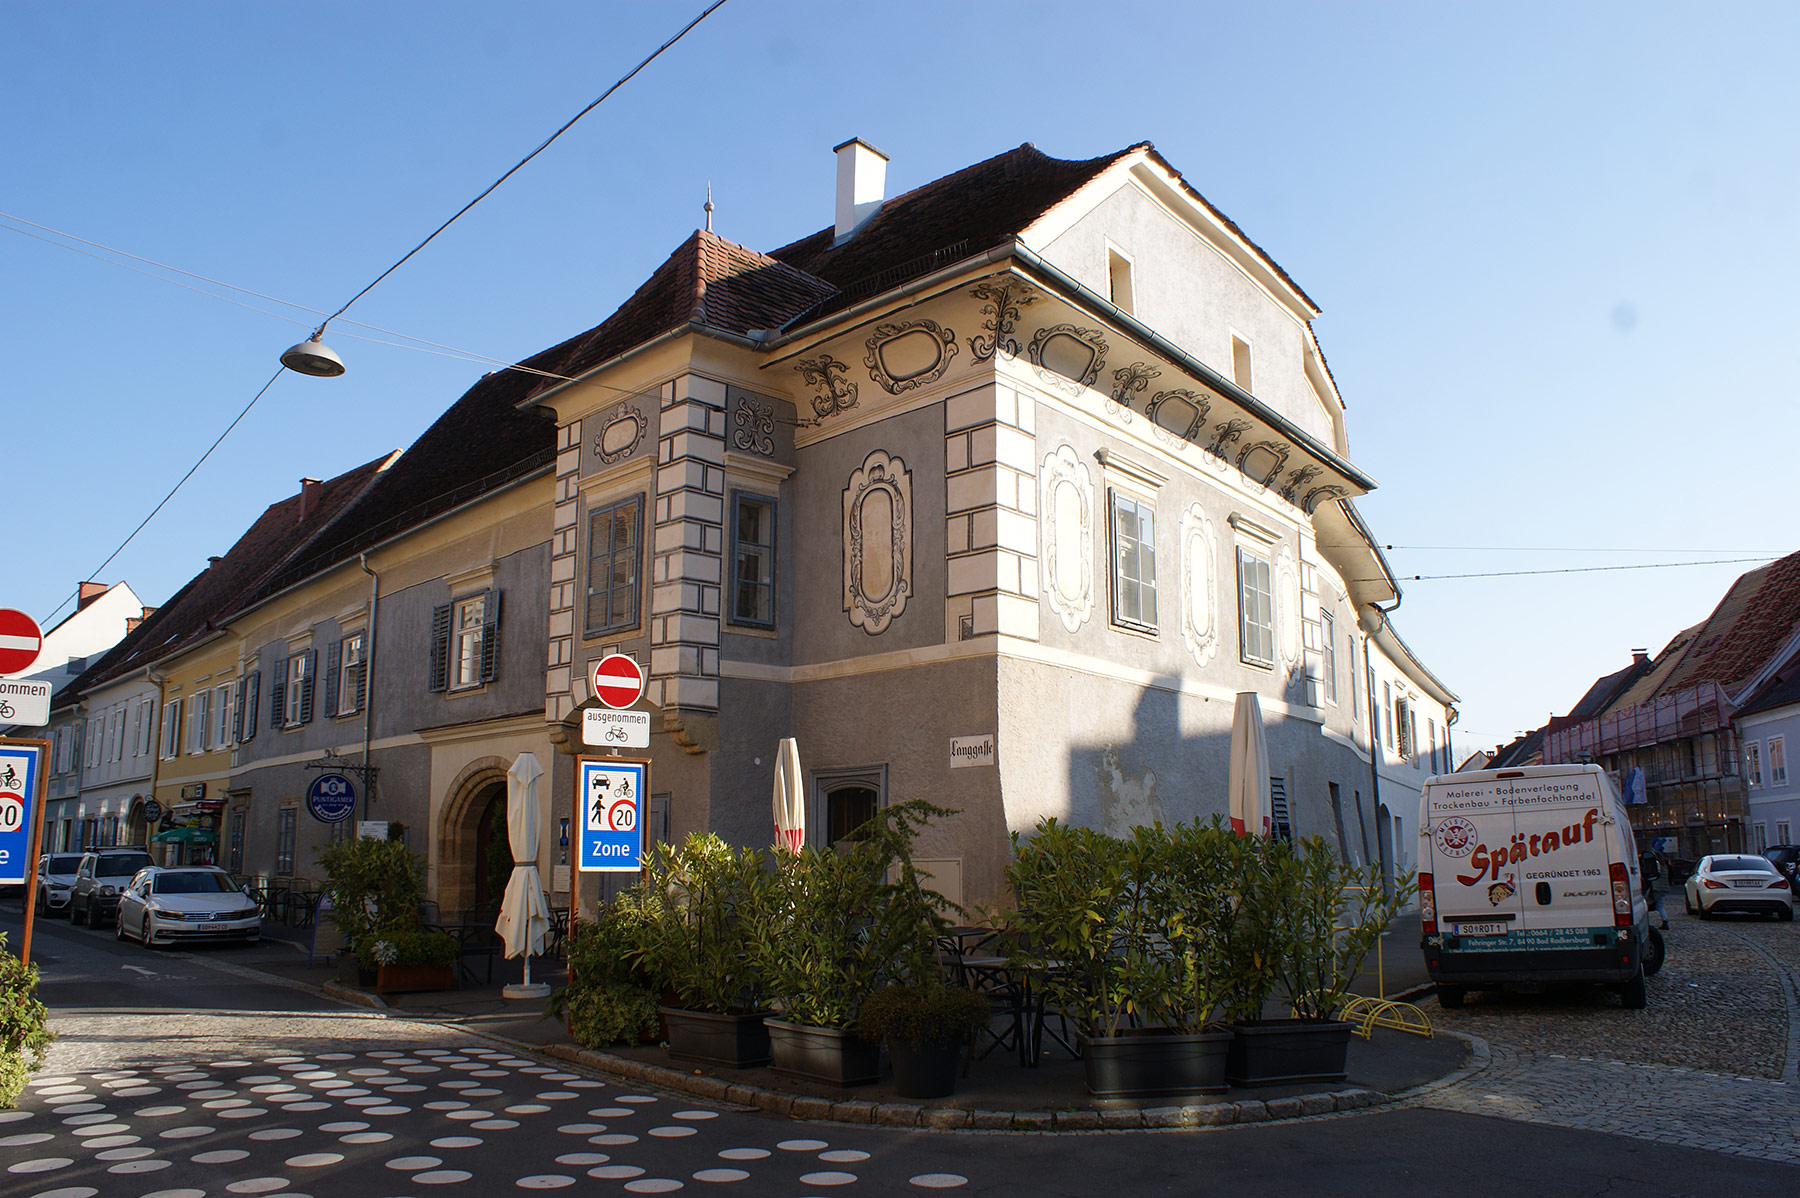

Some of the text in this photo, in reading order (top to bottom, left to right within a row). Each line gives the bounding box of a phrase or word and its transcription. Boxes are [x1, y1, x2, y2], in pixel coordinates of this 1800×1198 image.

[587, 712, 647, 724] ausgenommen
[1446, 783, 1580, 799] Malerei Bodenverlegung
[1433, 792, 1595, 810] Trockenbau Farbenfachhandel
[616, 809, 633, 826] 20
[1439, 818, 1473, 833] MEISTER
[592, 841, 630, 857] Zone
[1456, 808, 1598, 887] Spätauf
[1525, 868, 1601, 880] GEGRÜNDET 1963
[1479, 924, 1495, 933] ROT
[1537, 937, 1549, 945] Bad
